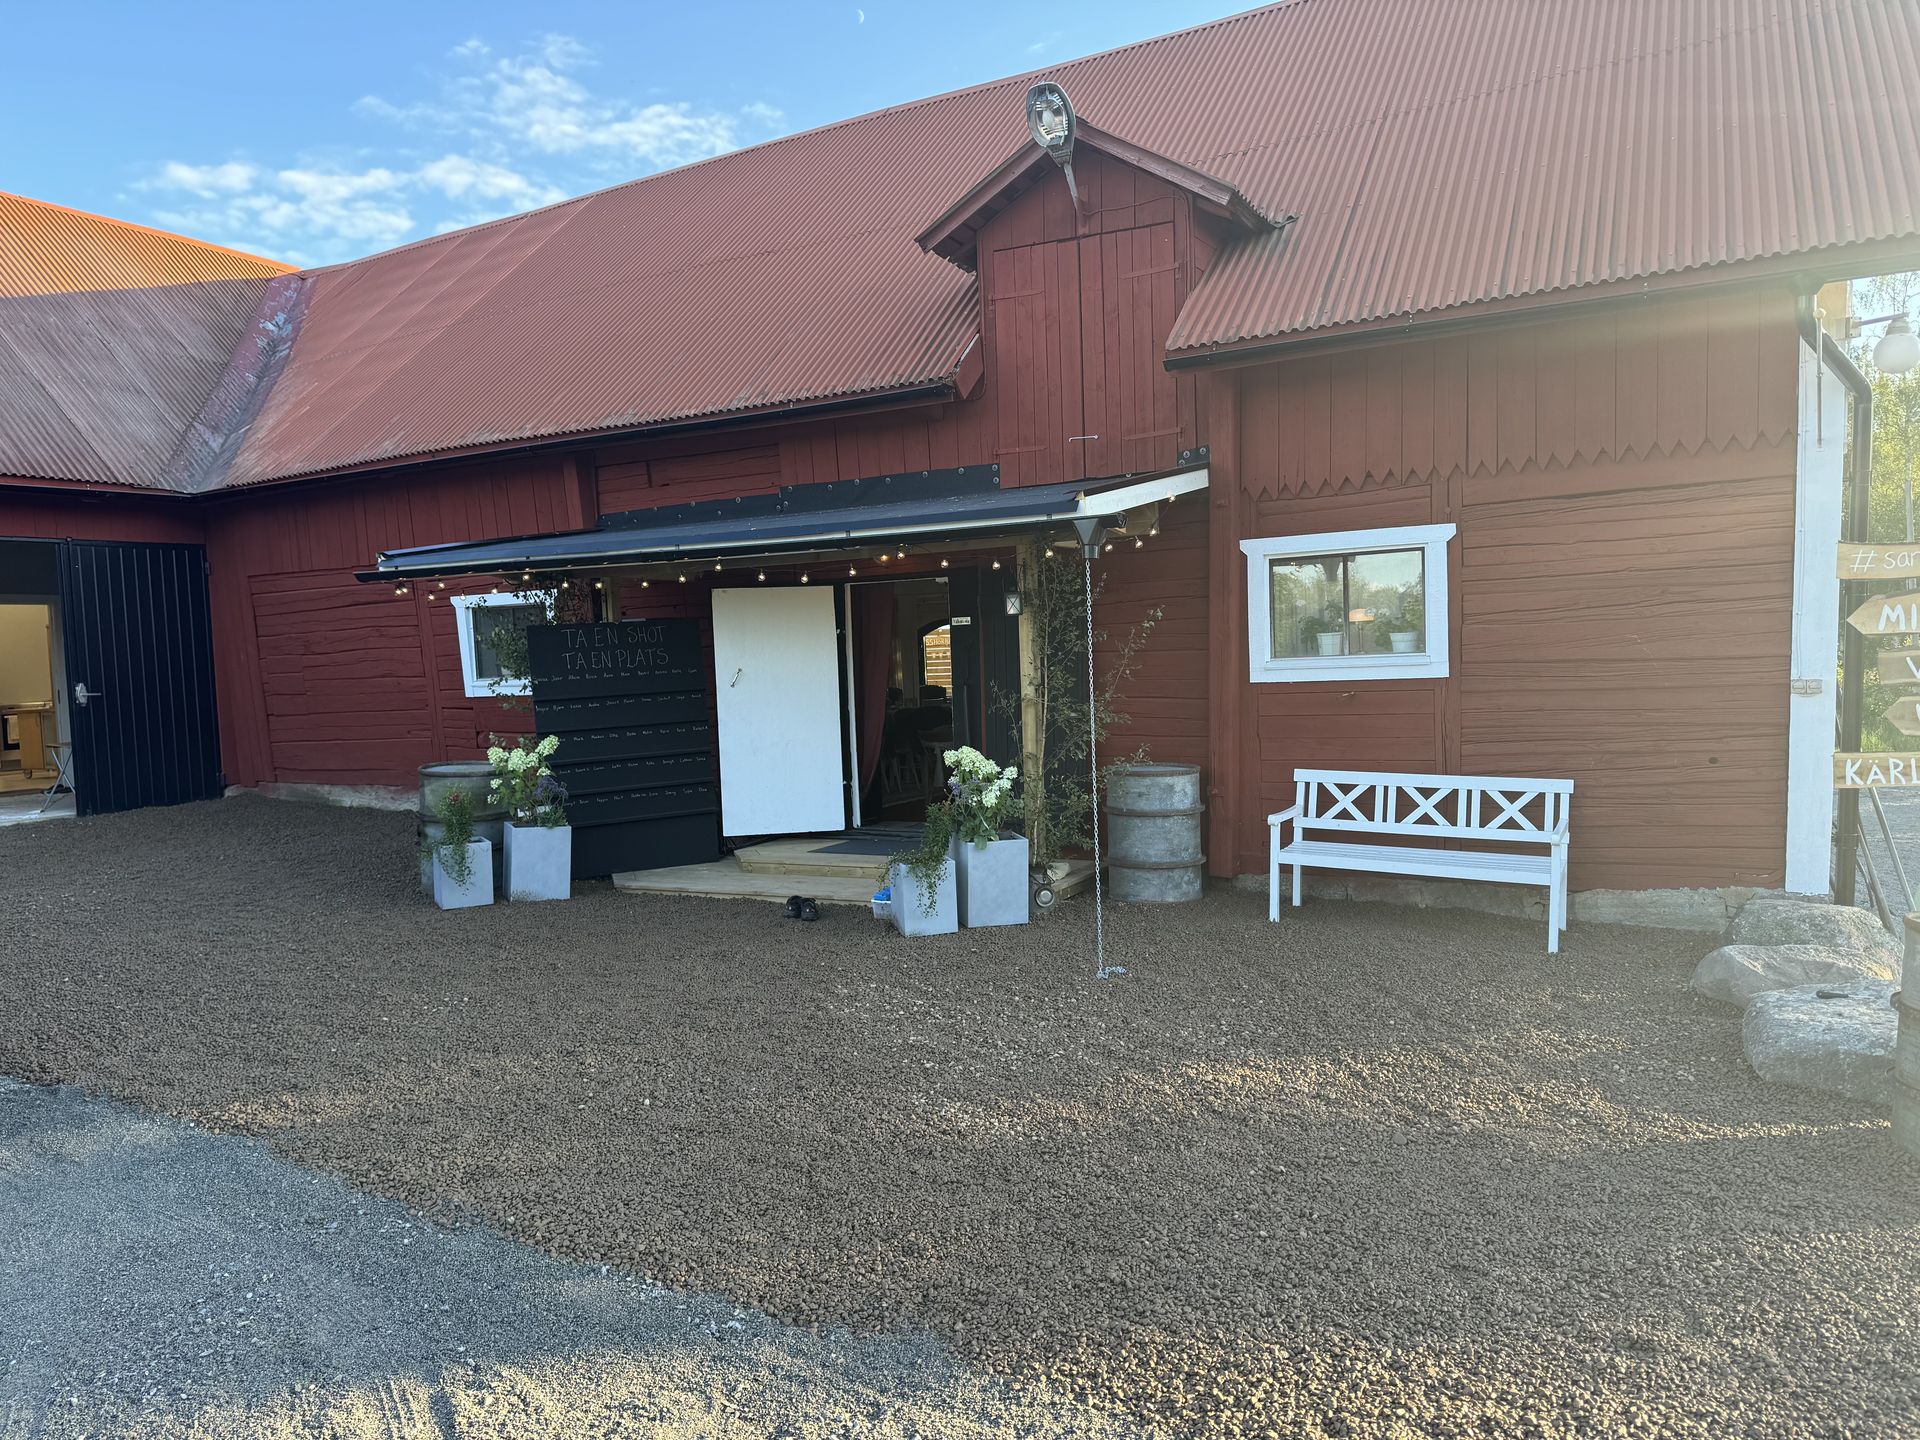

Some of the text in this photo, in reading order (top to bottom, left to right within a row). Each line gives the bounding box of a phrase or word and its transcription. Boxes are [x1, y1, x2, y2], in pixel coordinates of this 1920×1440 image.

[560, 625, 666, 648] TA EN SHOT
[561, 648, 669, 670] TA EN PLATS
[1845, 757, 1920, 785] KÄRL
